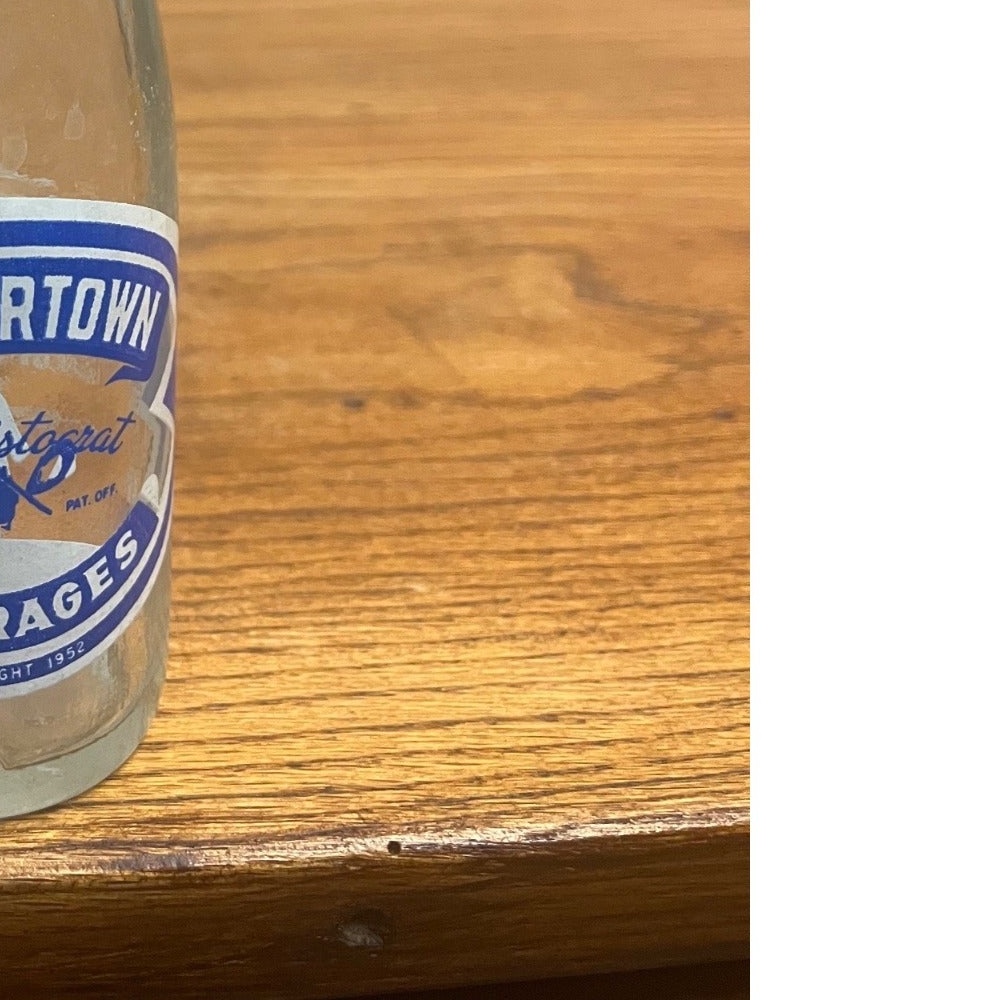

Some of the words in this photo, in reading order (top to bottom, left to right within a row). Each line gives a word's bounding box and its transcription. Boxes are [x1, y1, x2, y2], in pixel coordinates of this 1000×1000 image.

[66, 494, 91, 512] PAT.
[95, 483, 118, 503] OFF.
[47, 640, 86, 669] 1952
